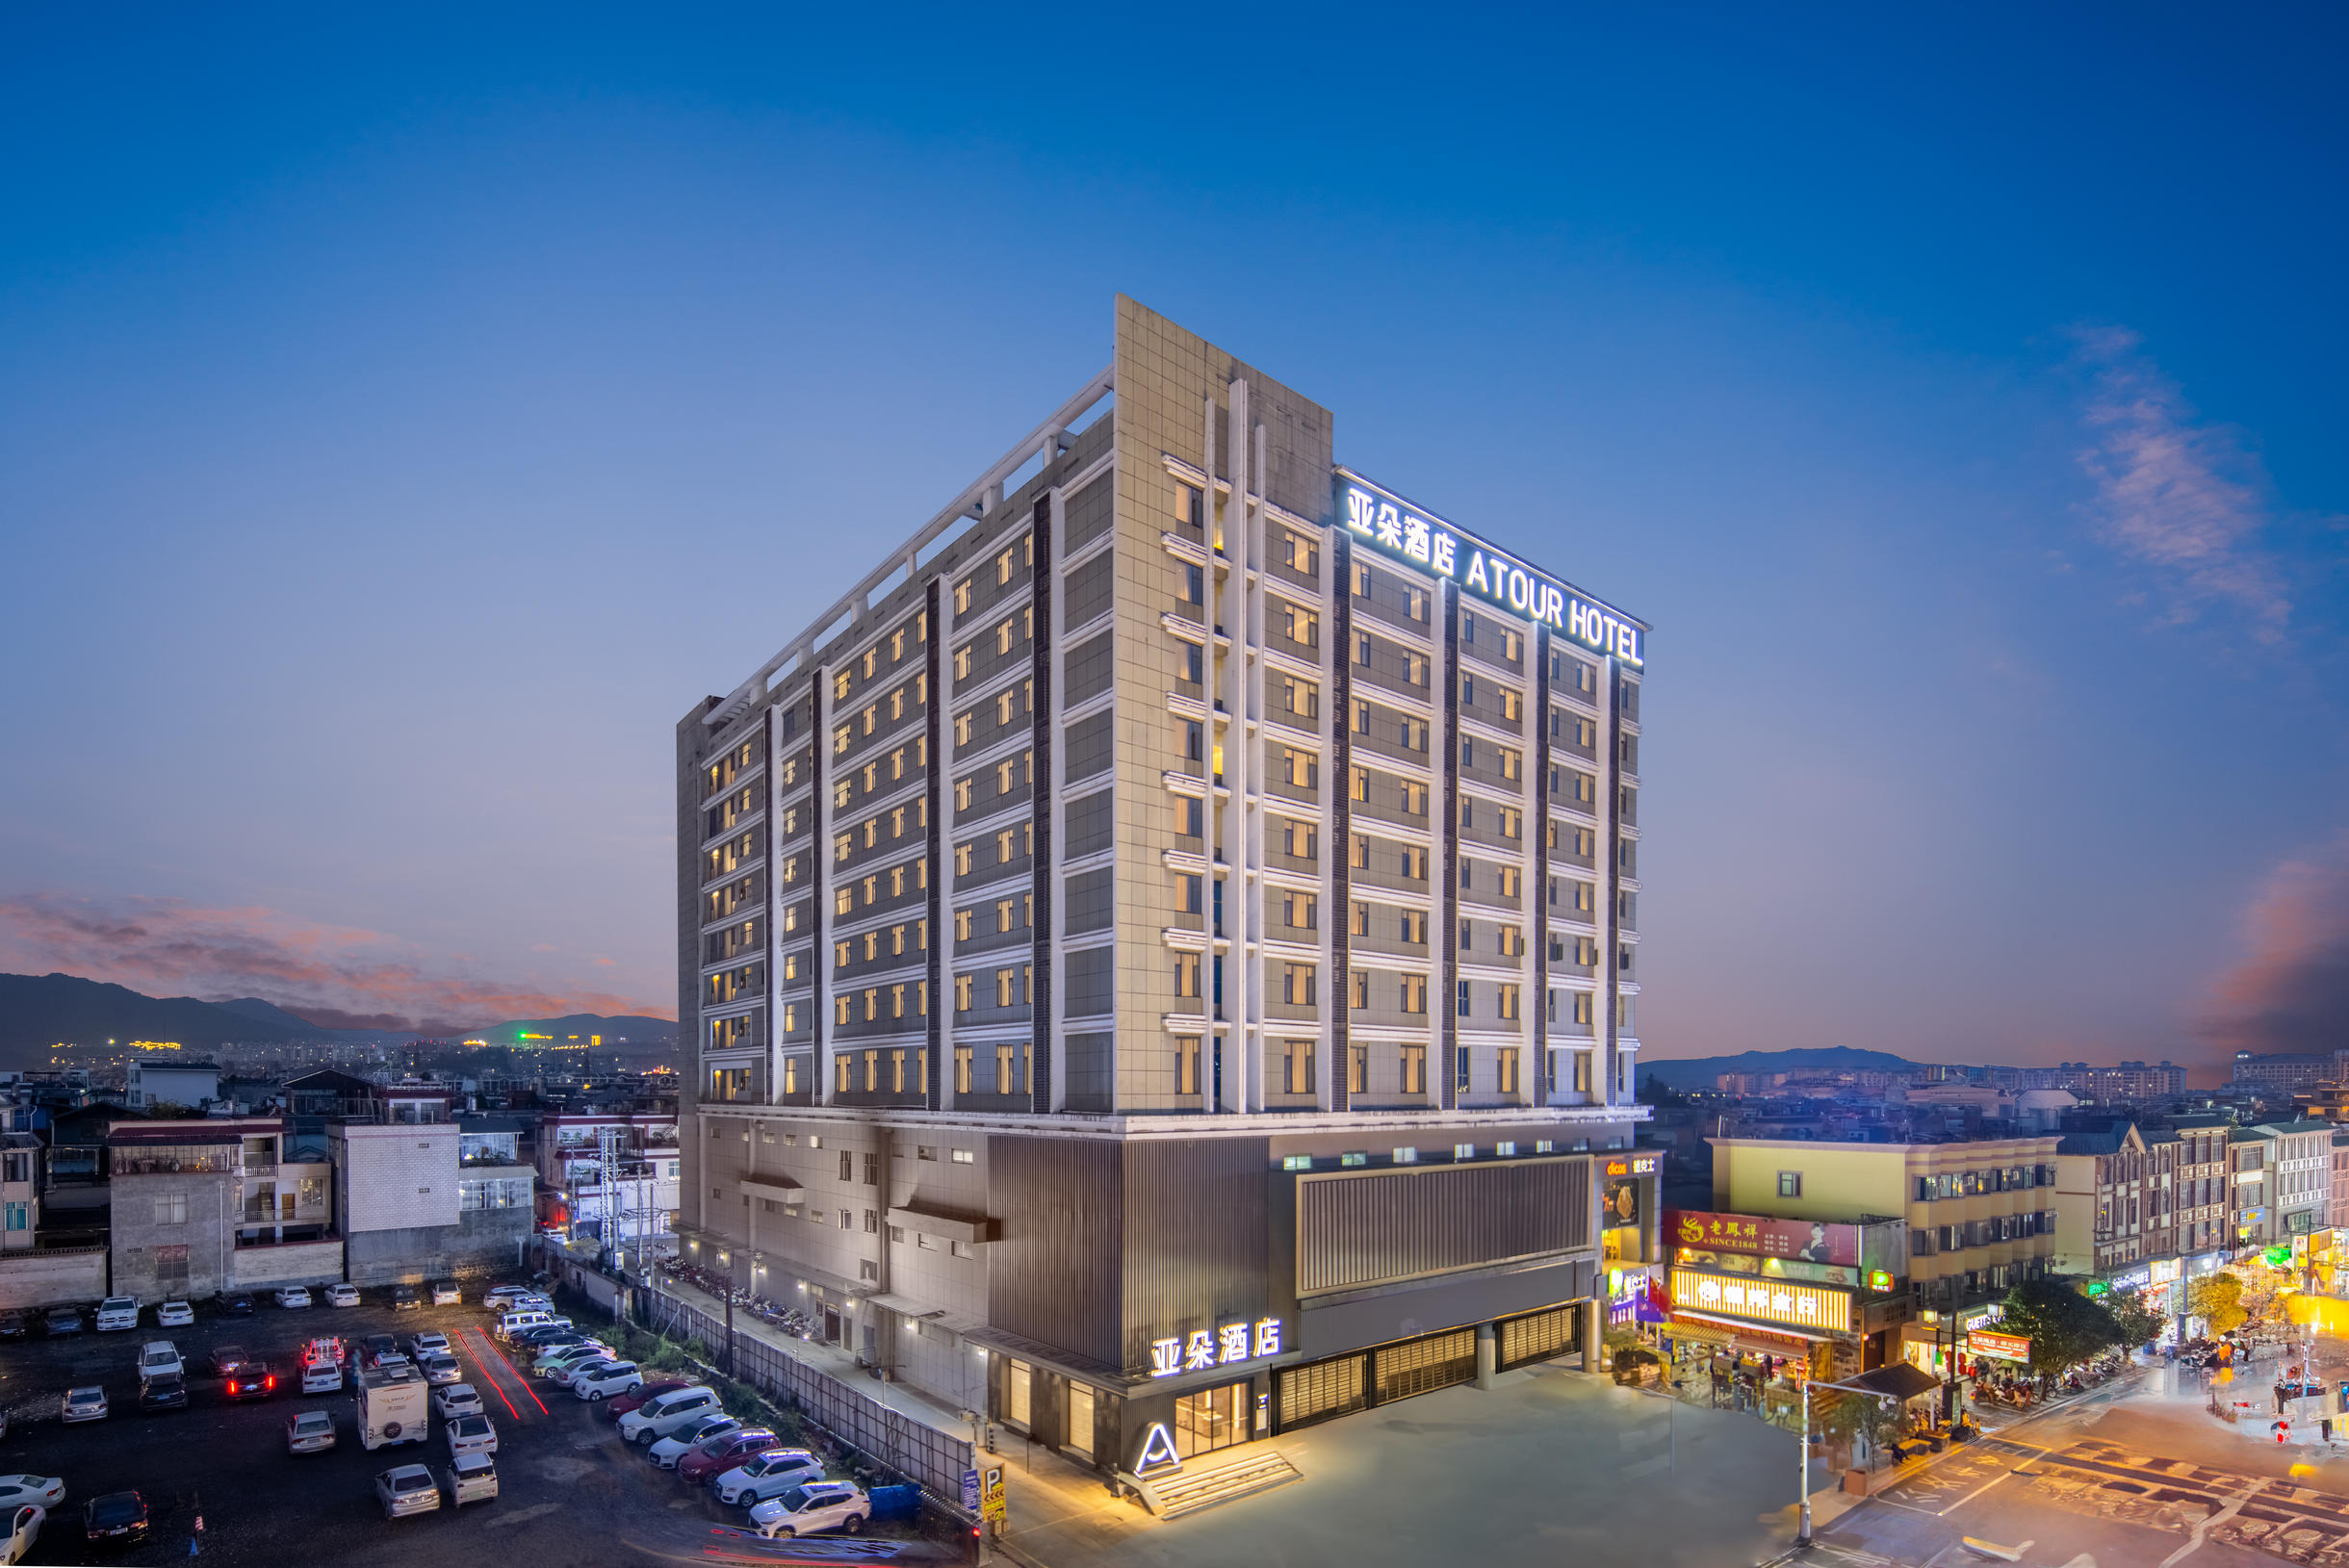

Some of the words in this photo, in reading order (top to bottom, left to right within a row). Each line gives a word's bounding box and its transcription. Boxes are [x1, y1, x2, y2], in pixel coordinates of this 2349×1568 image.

[1347, 487, 1457, 577] 亚朵酒店
[1466, 550, 1564, 629] ATOUR
[1569, 599, 1644, 667] HOTEL
[1607, 1161, 1627, 1175] dicos
[1151, 1317, 1281, 1378] 亚朵酒店
[986, 1468, 1001, 1495] P
